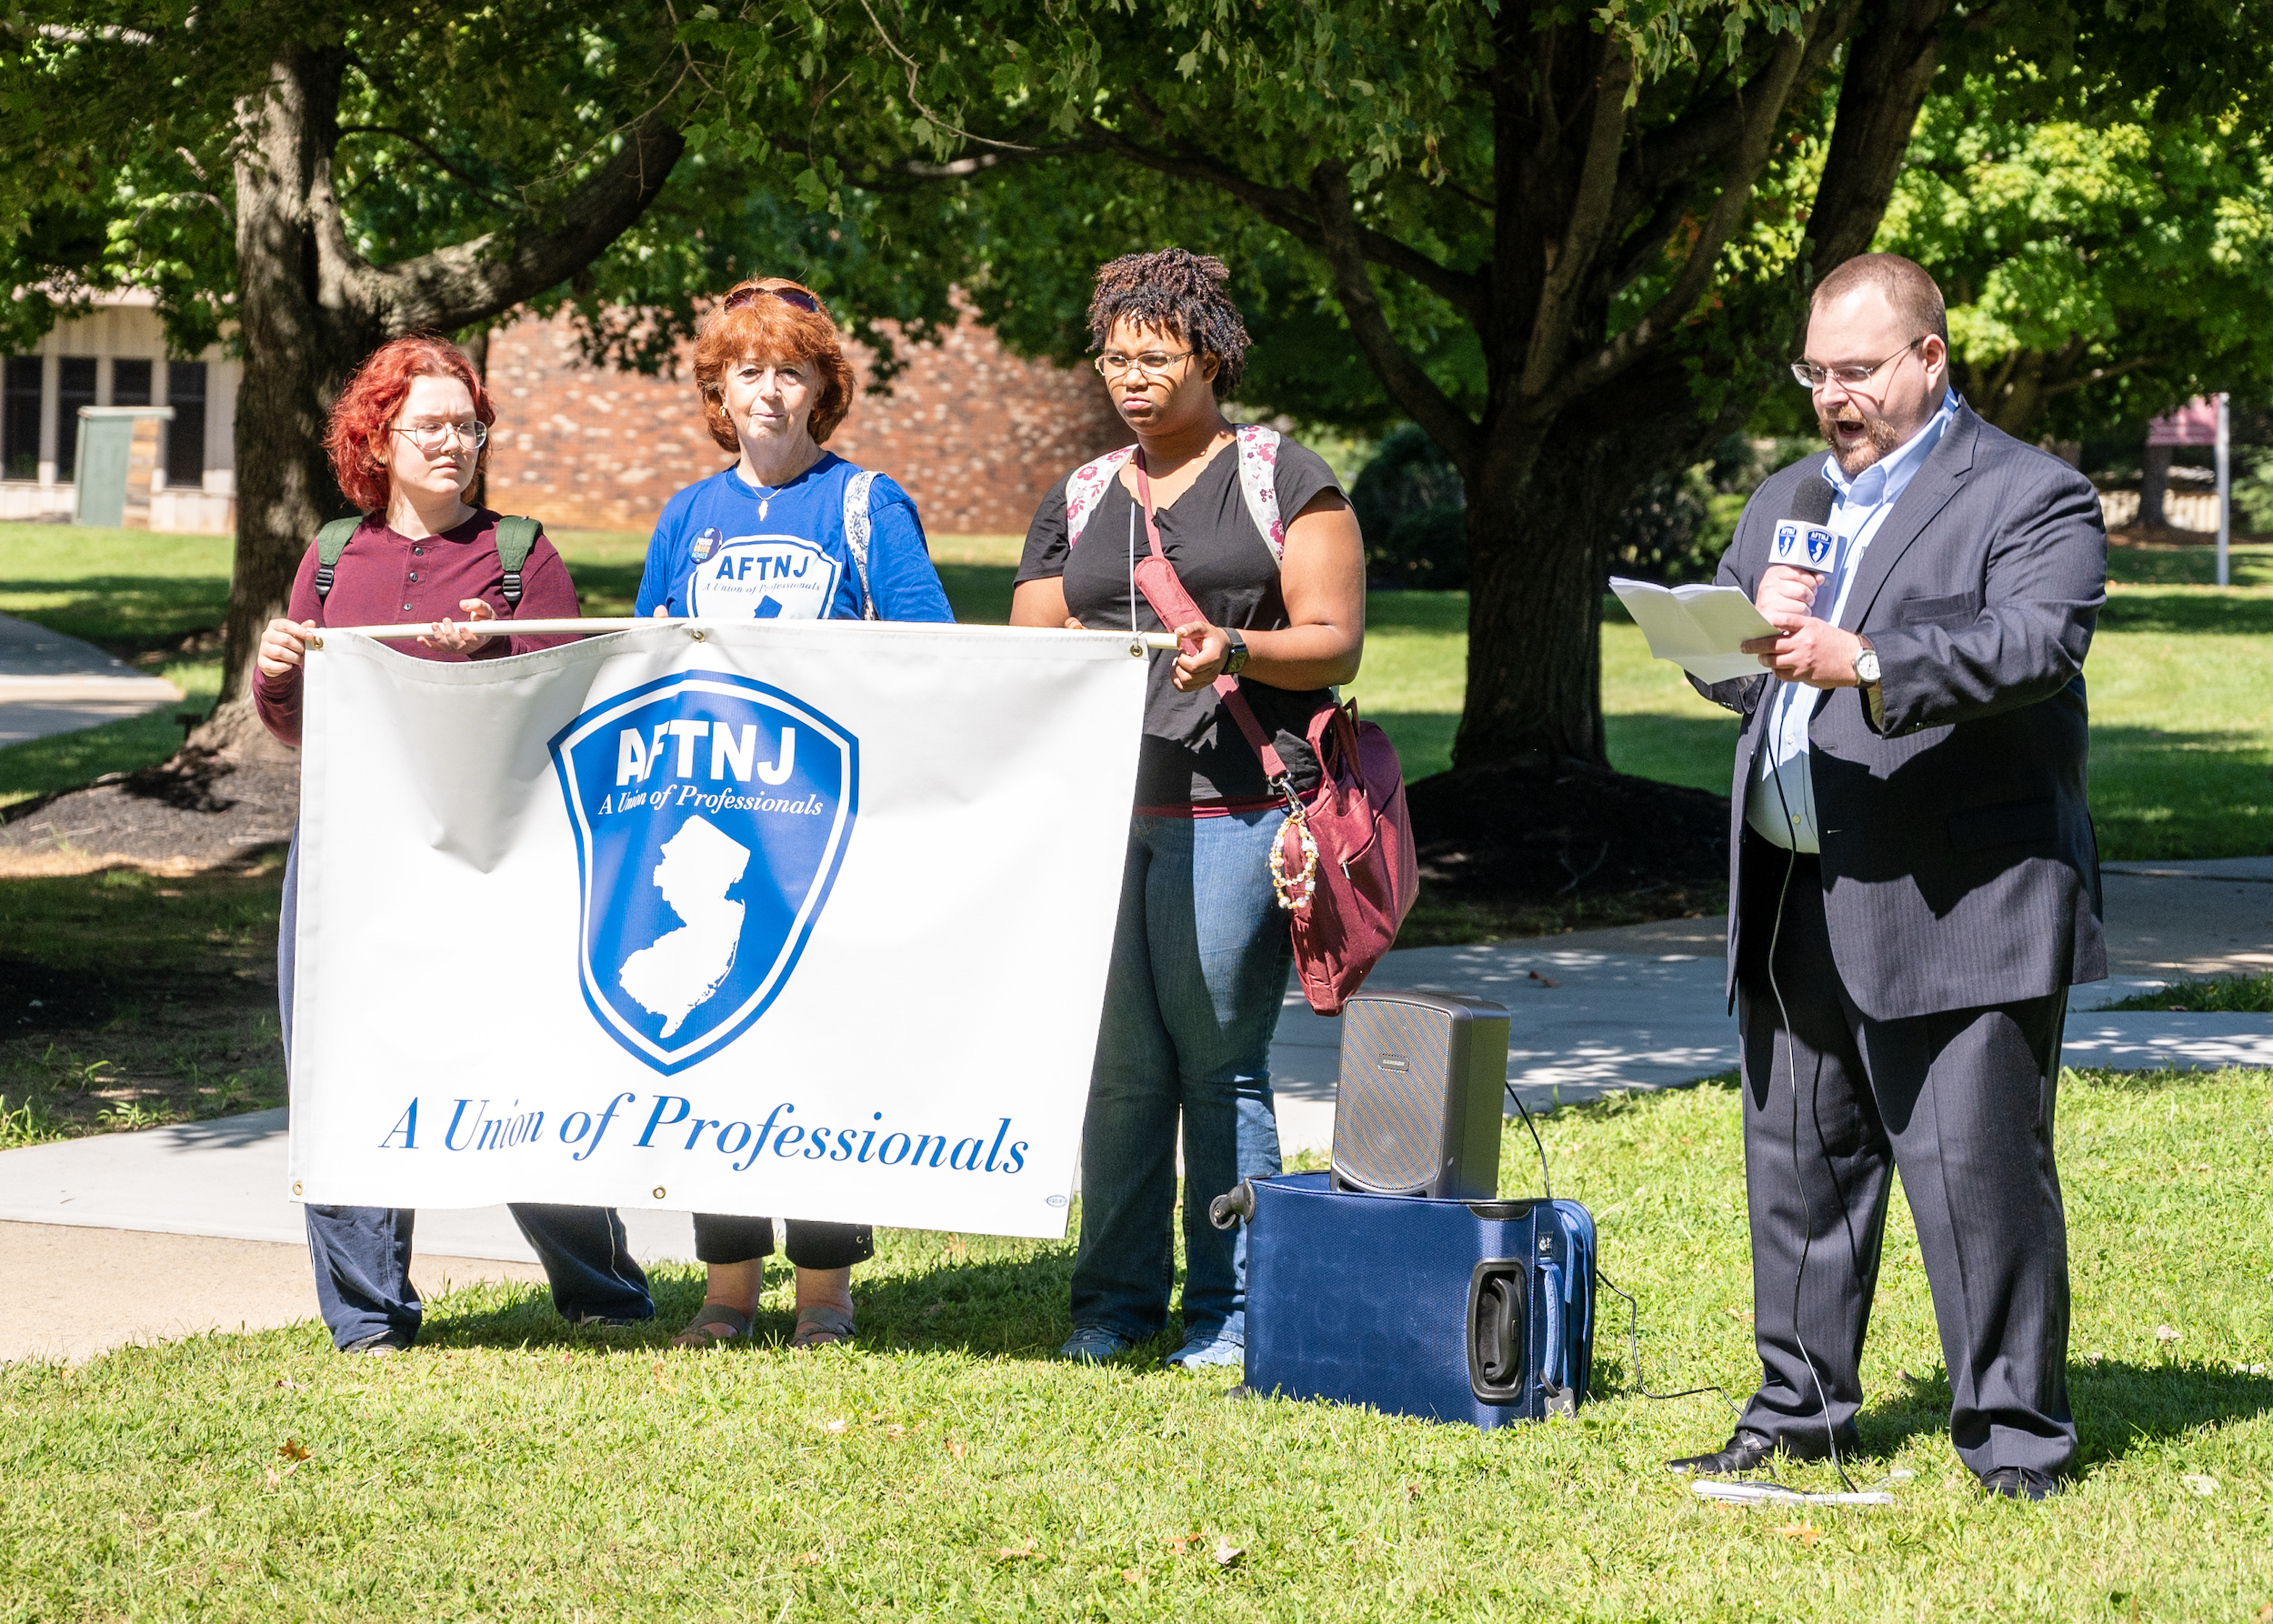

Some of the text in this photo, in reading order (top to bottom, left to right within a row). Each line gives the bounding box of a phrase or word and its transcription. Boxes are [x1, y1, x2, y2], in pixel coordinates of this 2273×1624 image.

[716, 555, 809, 580] AFTNJ
[703, 580, 820, 596] A Union of Professionals
[616, 719, 796, 786] AFTNJ
[598, 784, 824, 816] A Union of Professionals
[377, 1091, 1029, 1175] A Union of Professionals
